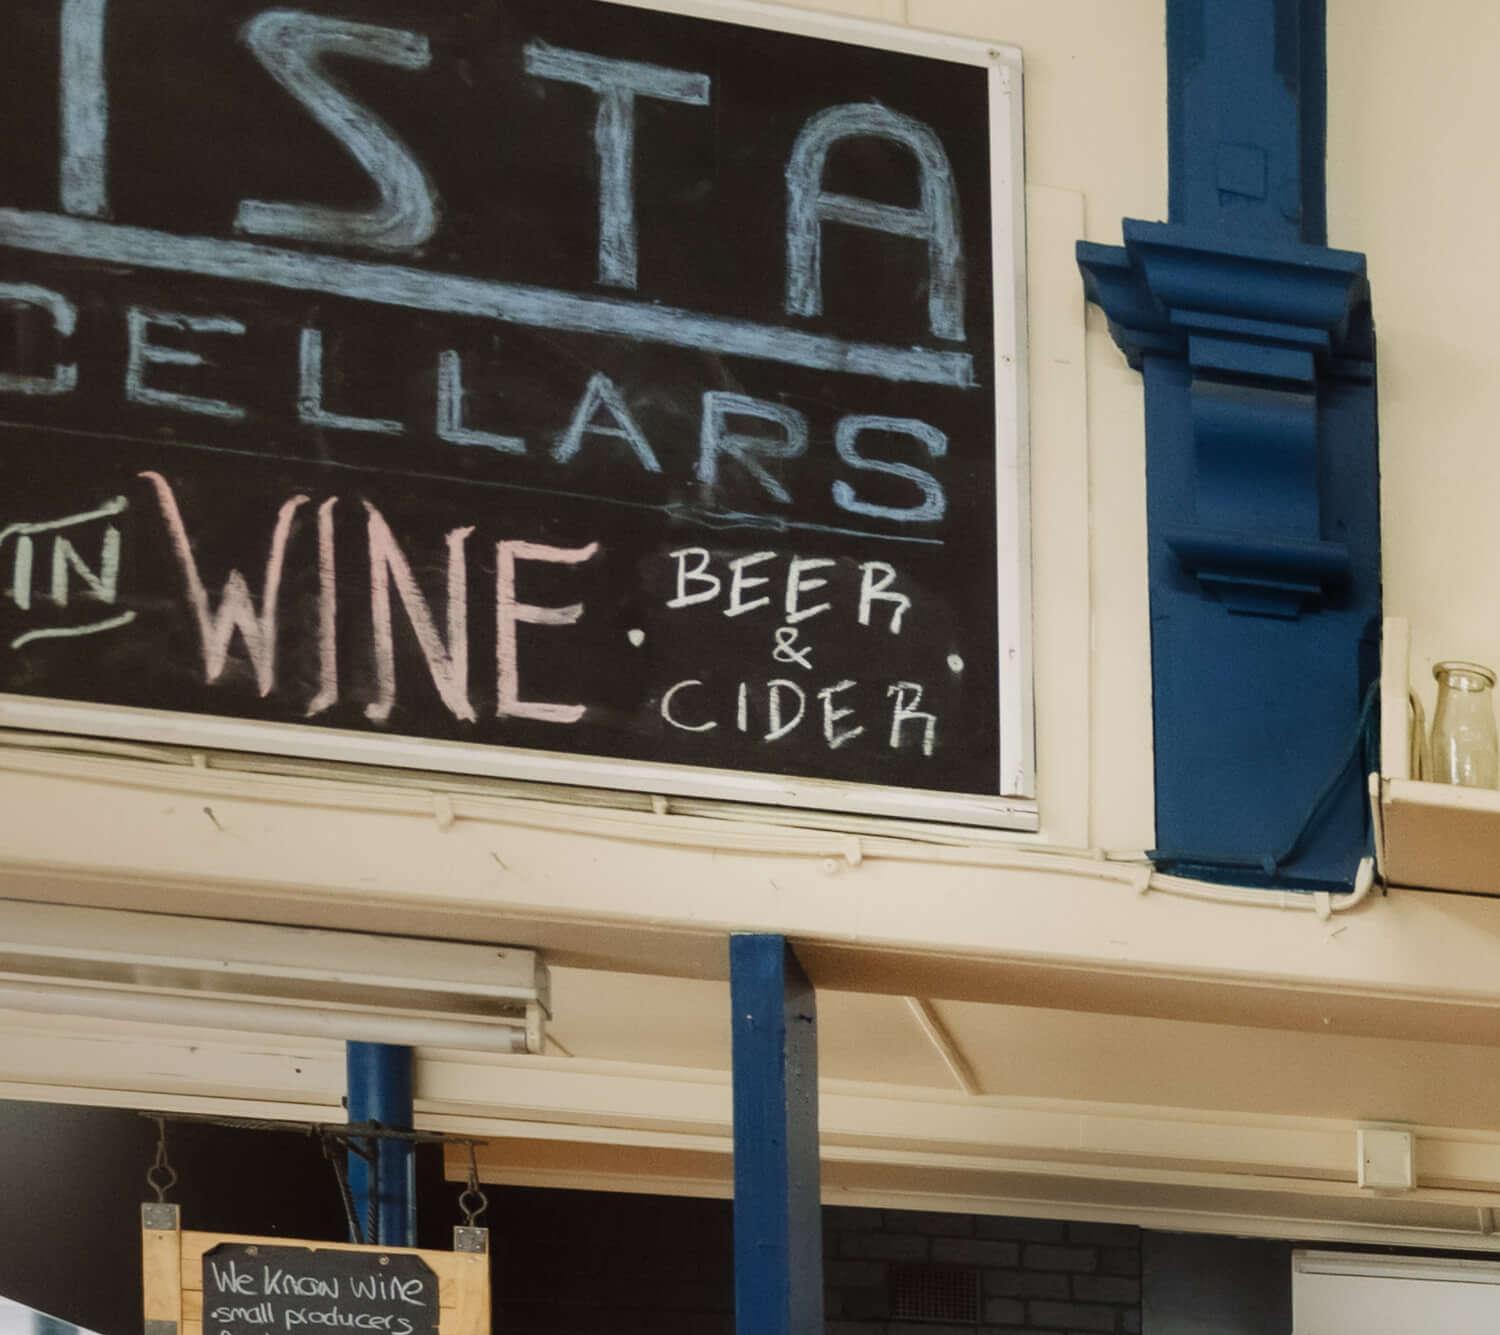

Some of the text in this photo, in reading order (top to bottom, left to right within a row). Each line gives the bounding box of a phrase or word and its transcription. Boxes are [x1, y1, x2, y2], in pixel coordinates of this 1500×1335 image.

[138, 470, 598, 724] WINE
[668, 548, 912, 636] BEER
[772, 626, 813, 670] &
[662, 680, 937, 757] CIDER
[212, 1260, 257, 1296] We
[216, 1303, 413, 1335] small producers
